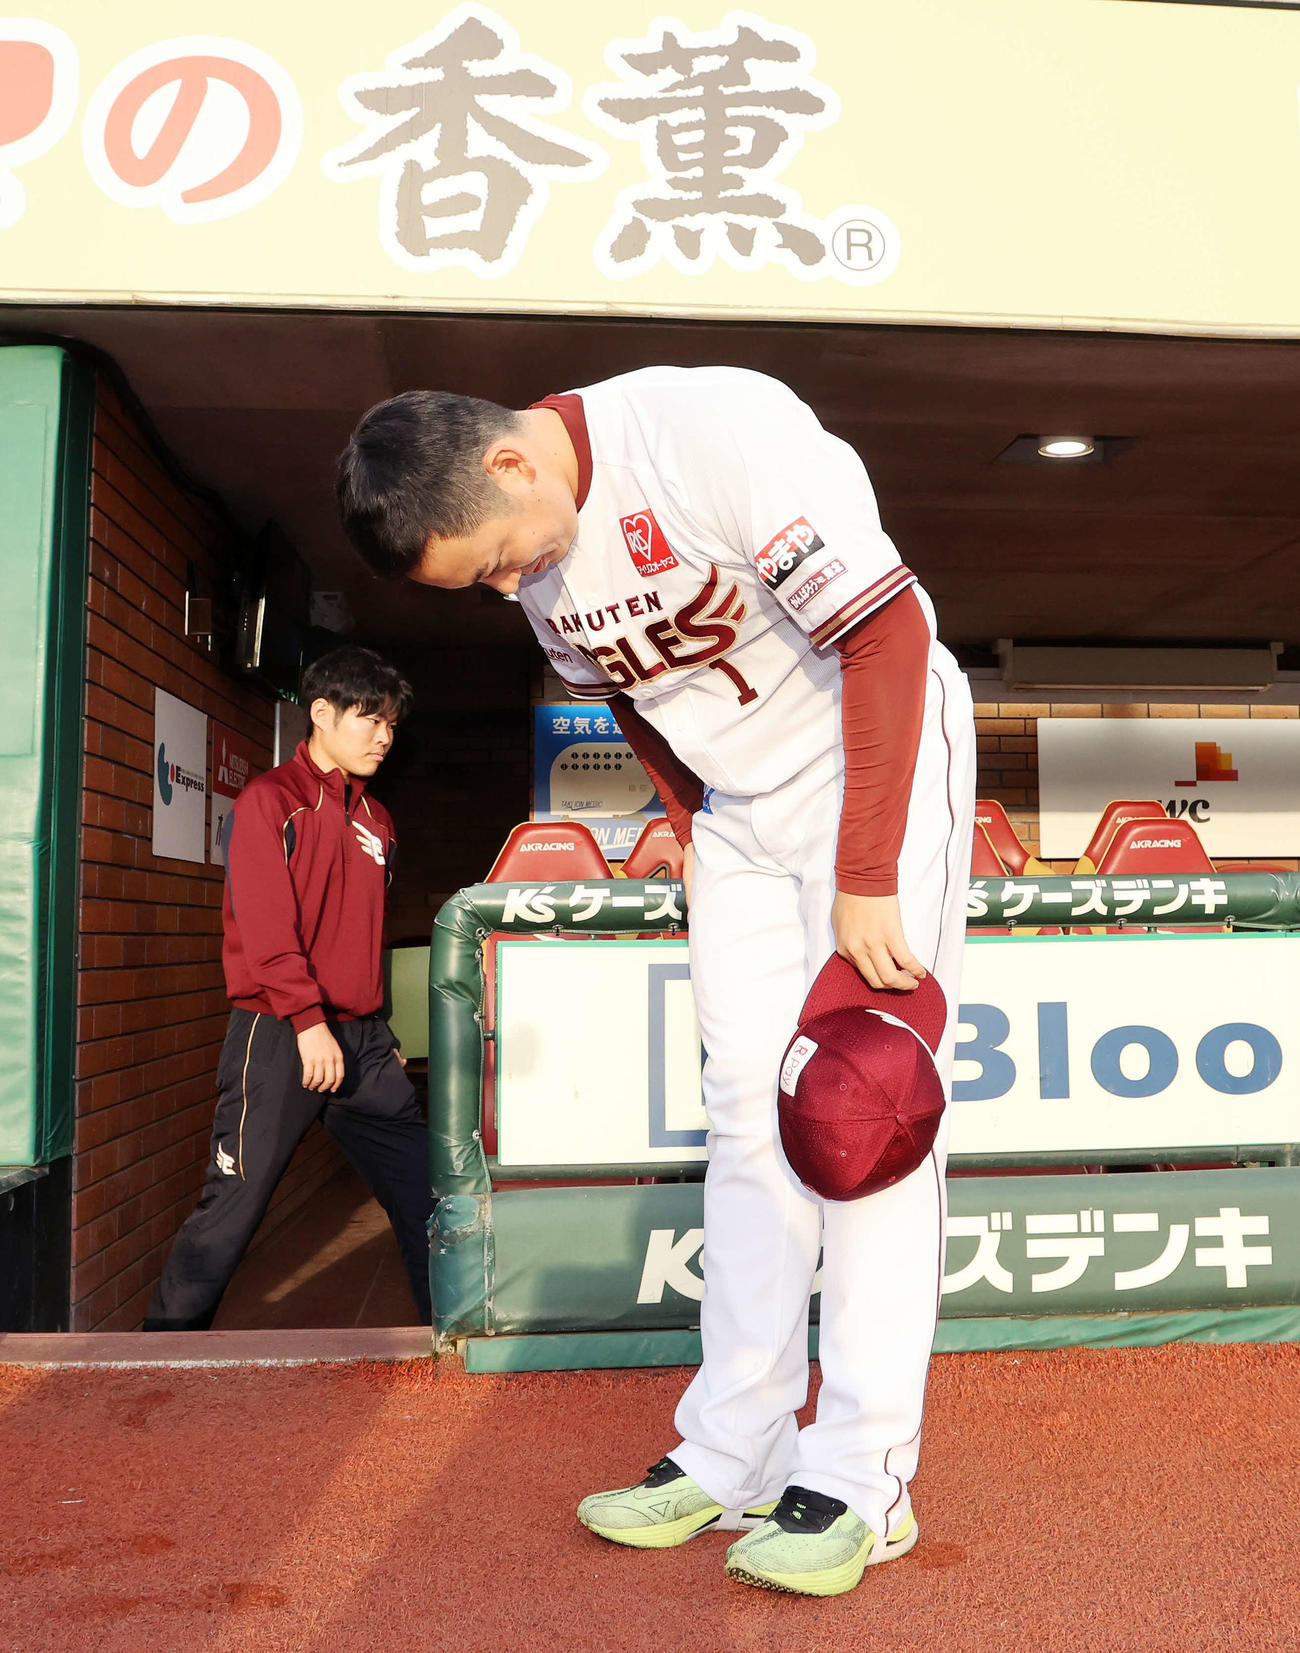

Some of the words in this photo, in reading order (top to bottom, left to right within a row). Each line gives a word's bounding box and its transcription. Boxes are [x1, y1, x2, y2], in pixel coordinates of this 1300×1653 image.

[757, 524, 815, 583] やまや
[708, 657, 759, 706] 1
[175, 765, 205, 792] Express
[1159, 798, 1211, 824] wc
[519, 842, 575, 852] AKRACING
[1129, 839, 1182, 849] AKRACING
[569, 884, 683, 921] ケーズ
[942, 1206, 1273, 1294] ズデンキ
